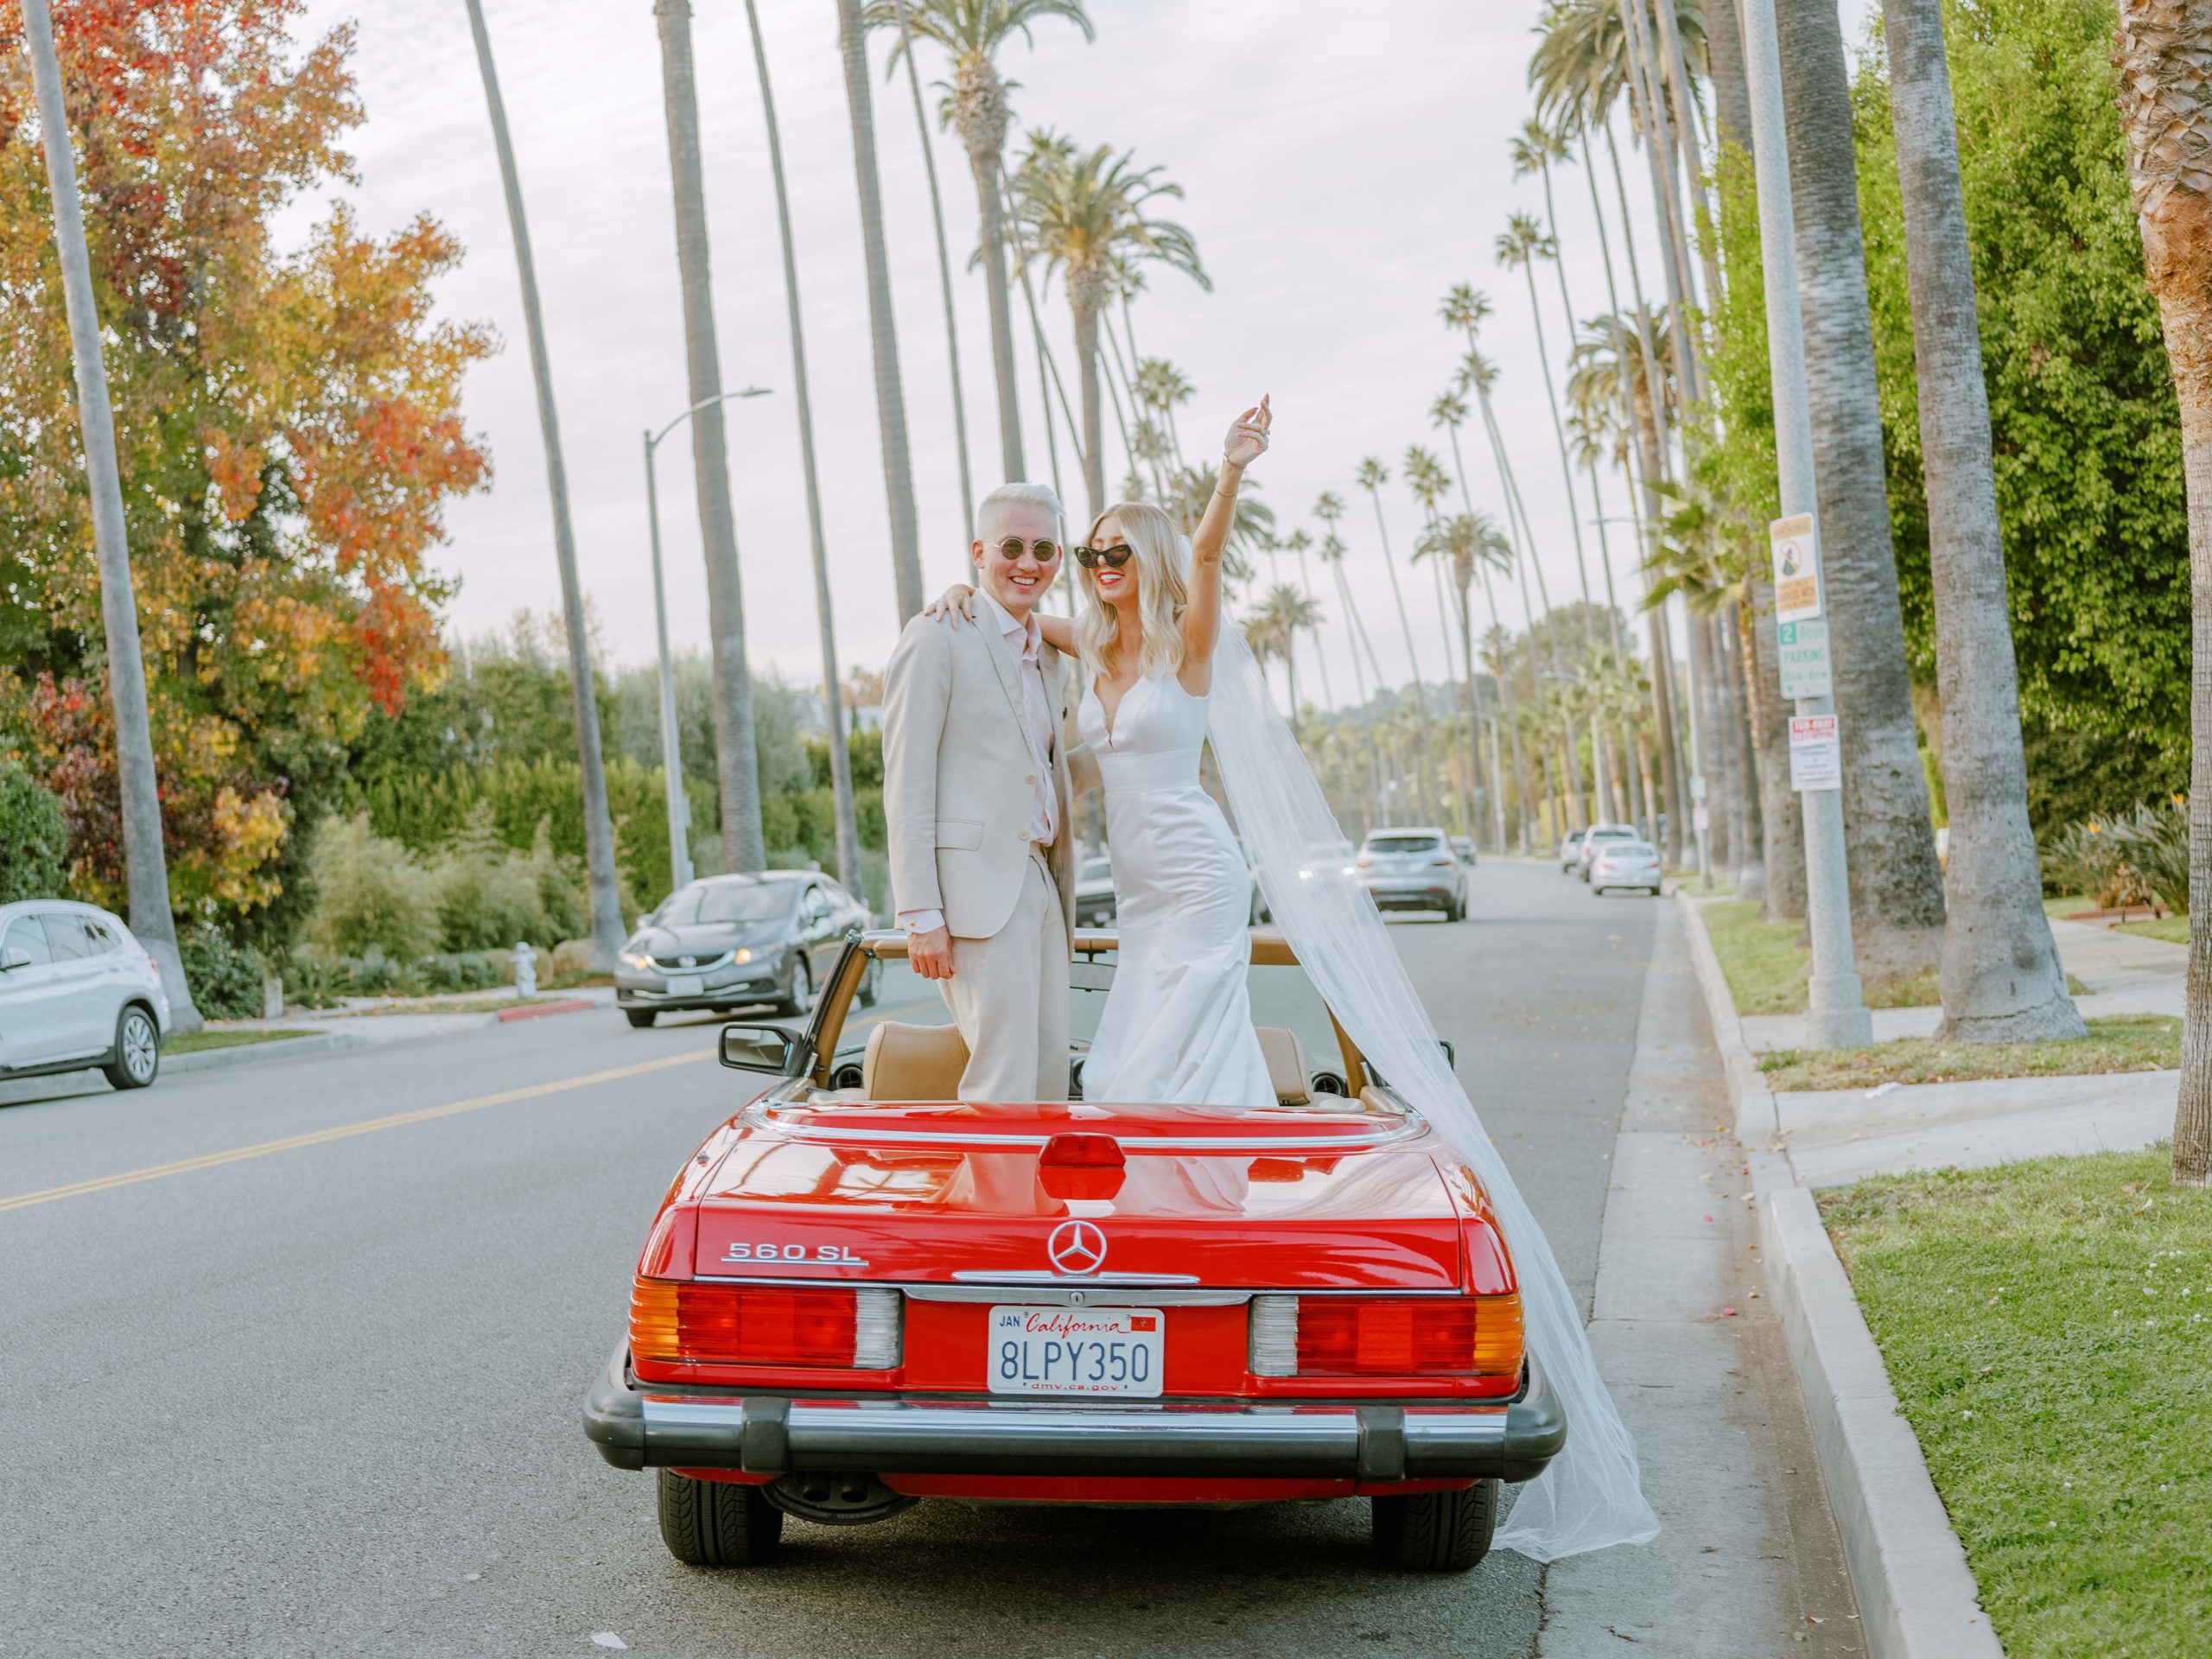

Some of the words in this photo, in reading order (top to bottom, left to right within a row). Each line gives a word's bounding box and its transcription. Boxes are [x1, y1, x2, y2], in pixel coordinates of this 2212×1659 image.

[1783, 624, 1793, 642] 2
[1783, 648, 1826, 664] PARKING
[729, 1243, 805, 1259] 560
[817, 1246, 861, 1262] SL
[1000, 1315, 1020, 1327] JAN
[1026, 1313, 1131, 1339] California
[1001, 1340, 1148, 1382] 8LPY350
[1032, 1382, 1119, 1392] dmv.ca.gov
